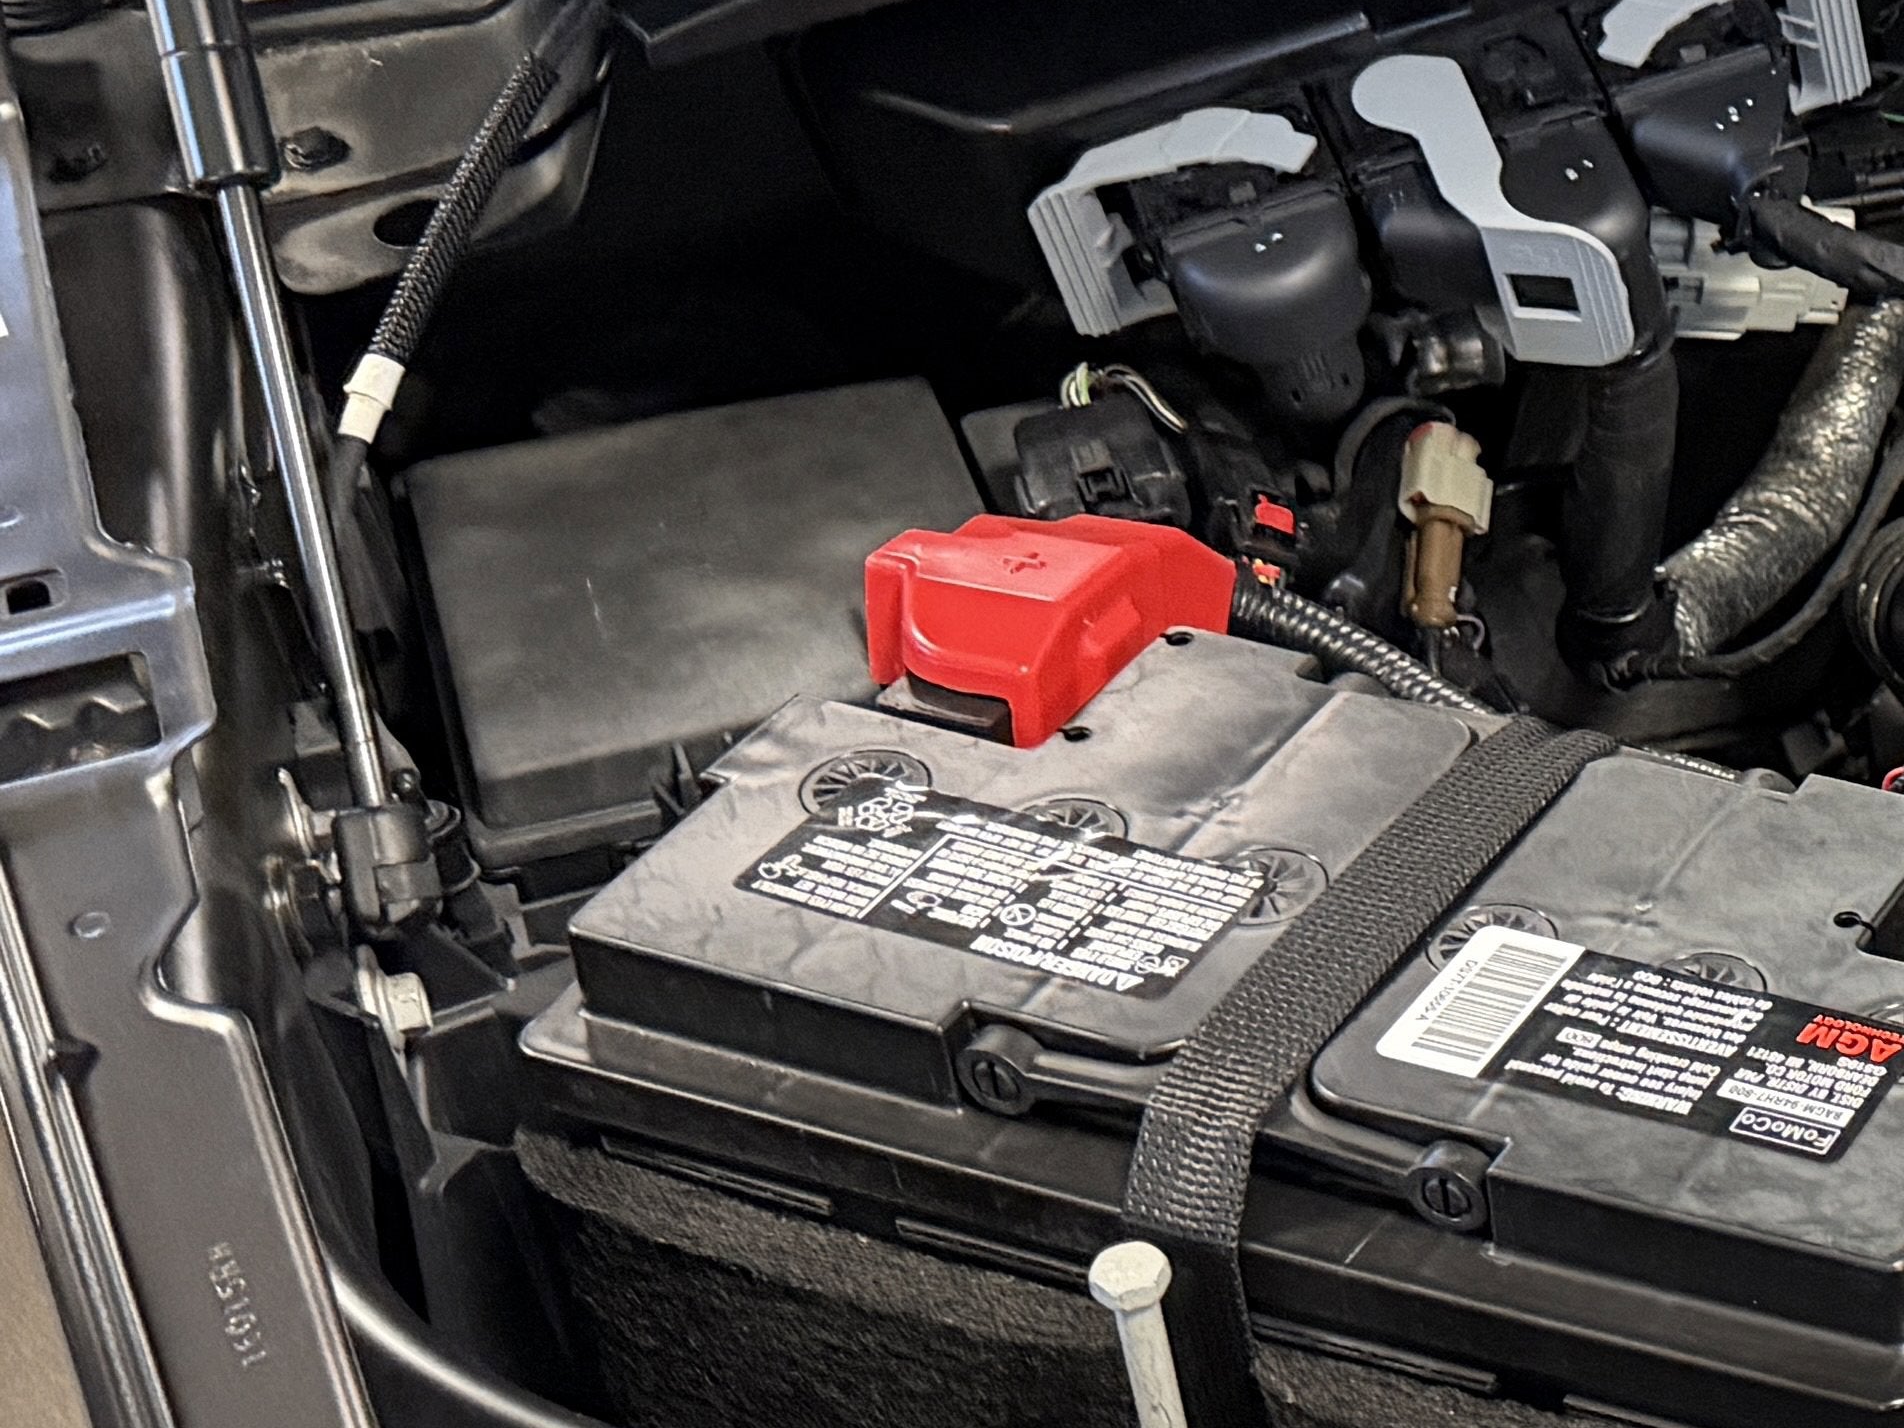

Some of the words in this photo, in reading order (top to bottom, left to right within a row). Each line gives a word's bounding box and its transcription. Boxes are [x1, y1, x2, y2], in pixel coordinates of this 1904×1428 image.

[1794, 1021, 1903, 1064] AGM
[1759, 1061, 1787, 1076] CO.
[1784, 1068, 1835, 1088] MOTOR
[1831, 1079, 1873, 1097] FORD
[1735, 1111, 1834, 1147] FoMoCo
